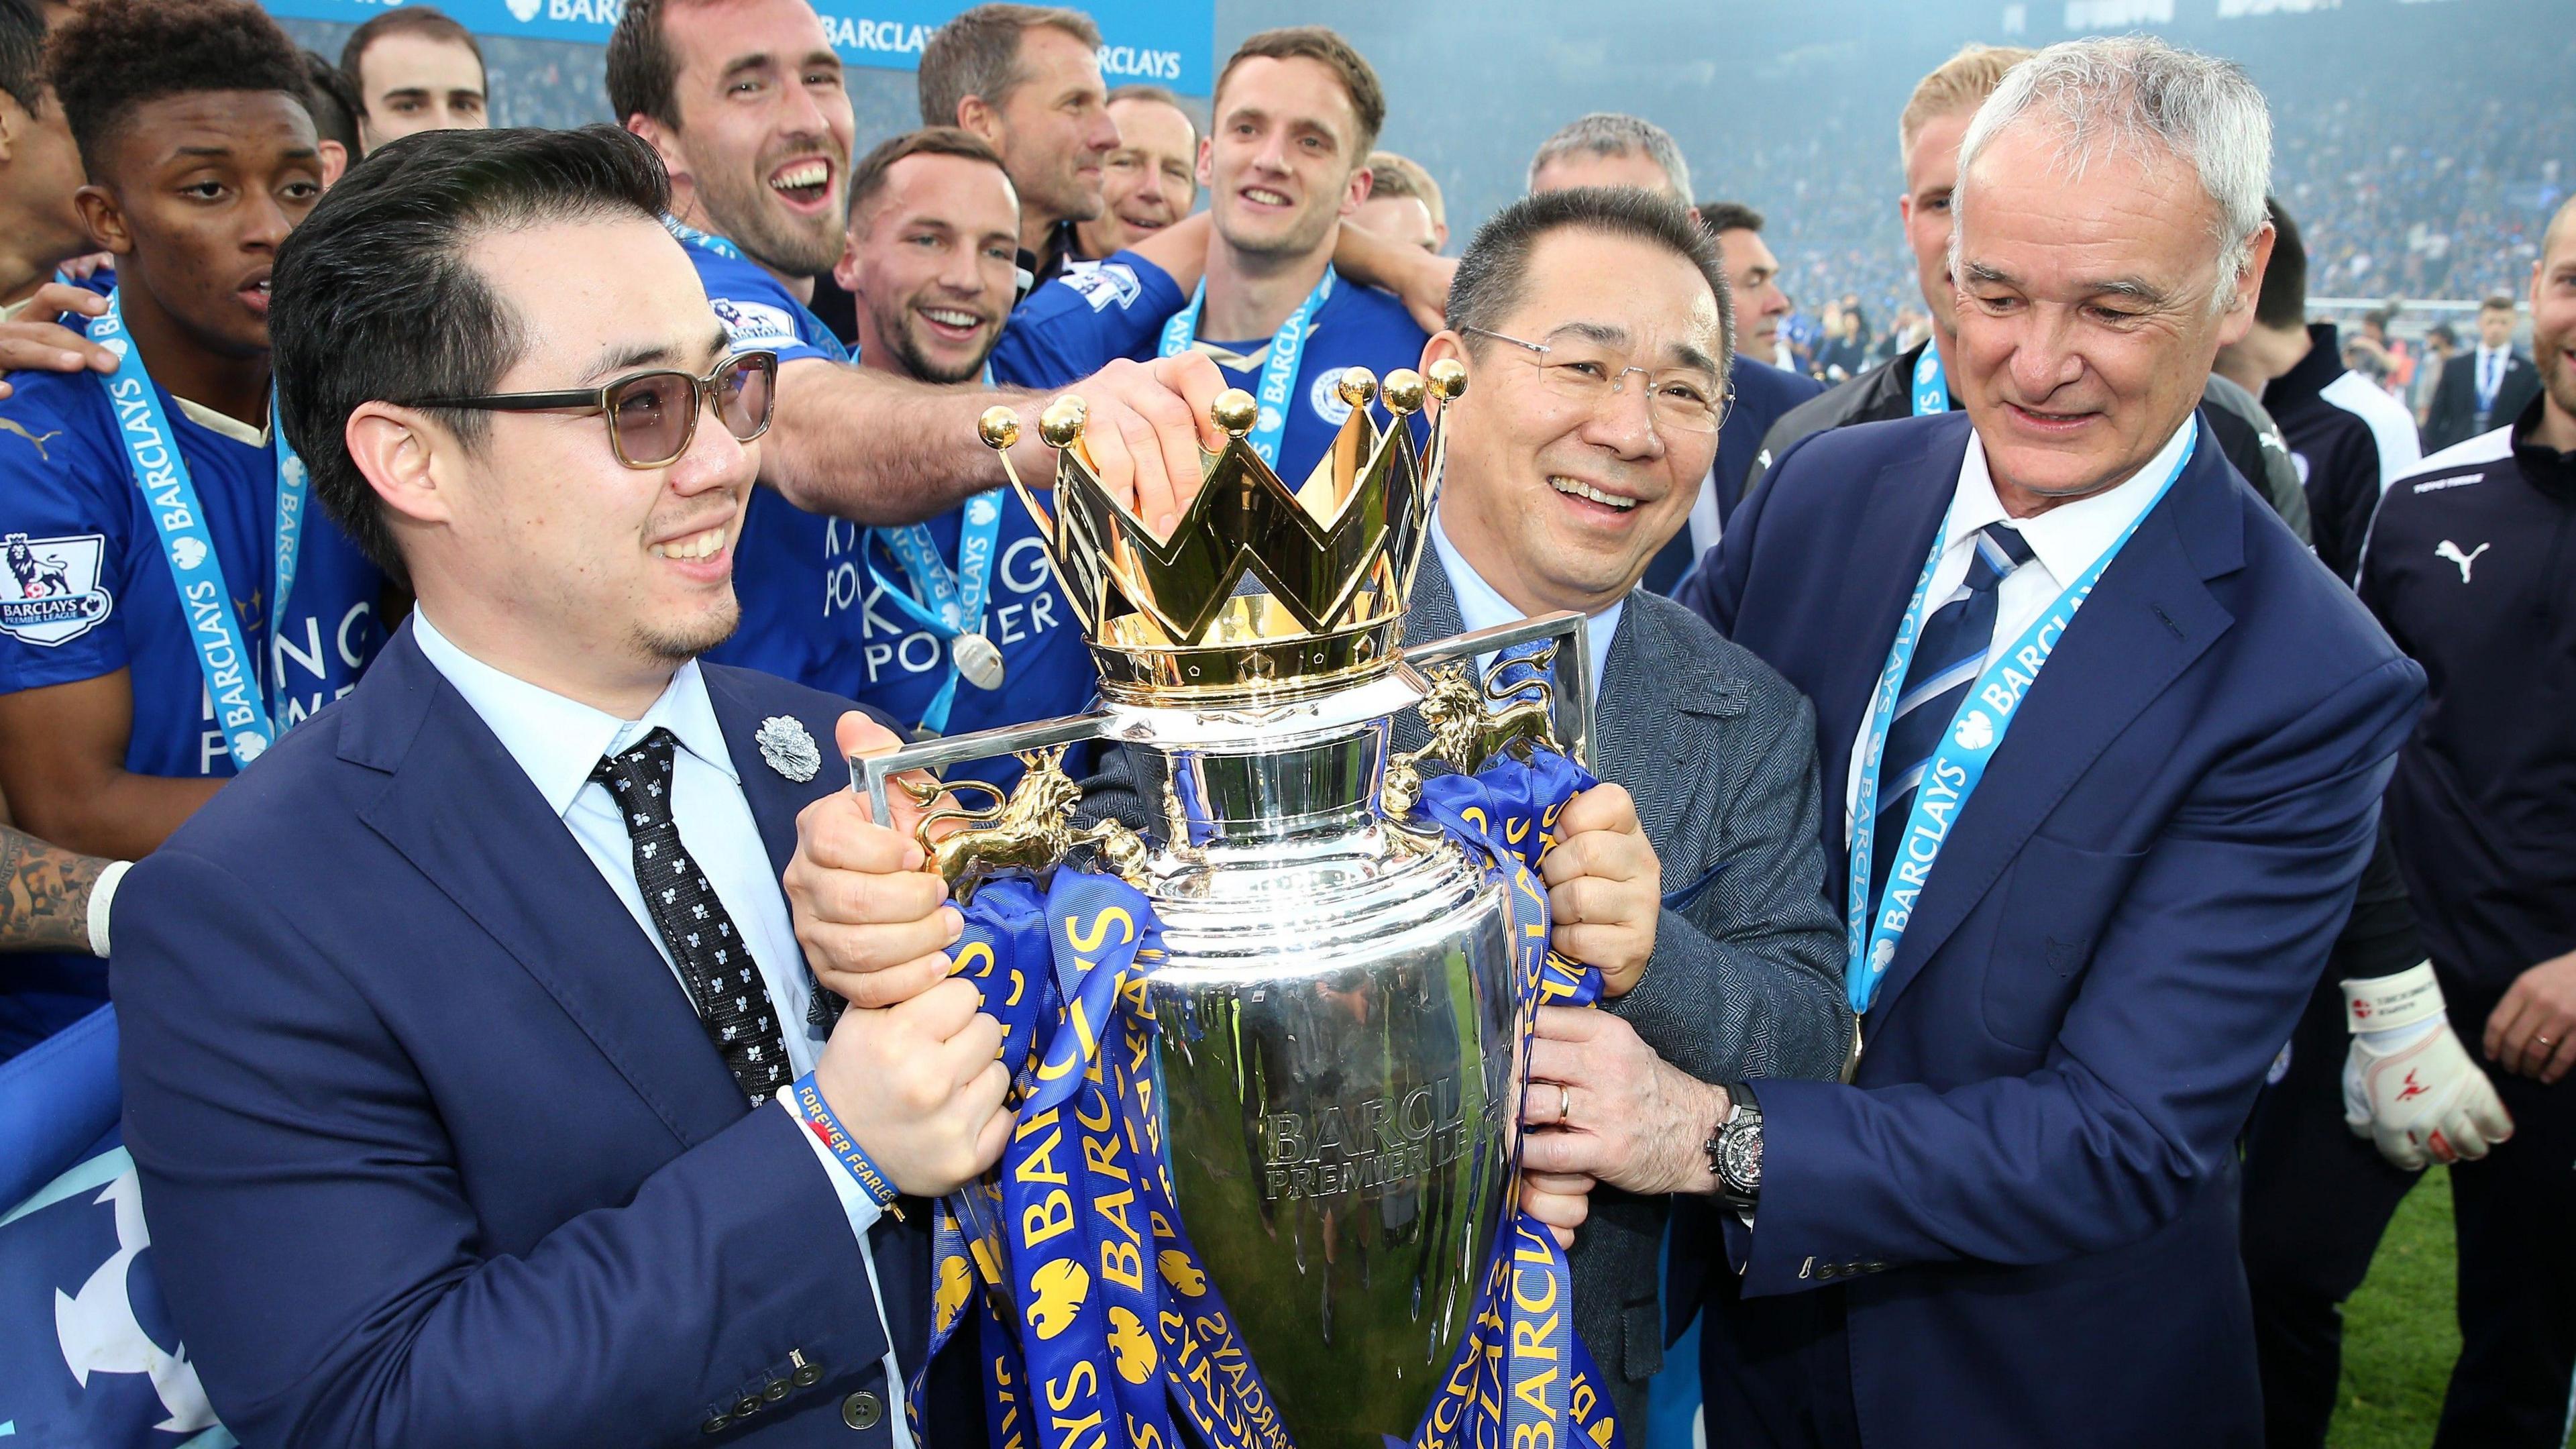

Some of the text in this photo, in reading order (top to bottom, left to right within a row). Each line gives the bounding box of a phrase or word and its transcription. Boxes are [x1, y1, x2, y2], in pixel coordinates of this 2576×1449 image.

[111, 378, 193, 533] BARCLAYS
[3, 599, 77, 616] BARCLAYS
[186, 580, 255, 729] BARCLAYS
[864, 592, 1059, 683] POER
[1847, 778, 1872, 958] BARCLAYS
[1882, 757, 1966, 933] BARCLAYS
[799, 1086, 896, 1202] FOREVER FEARLESS
[1266, 1144, 1431, 1201] PREMIER
